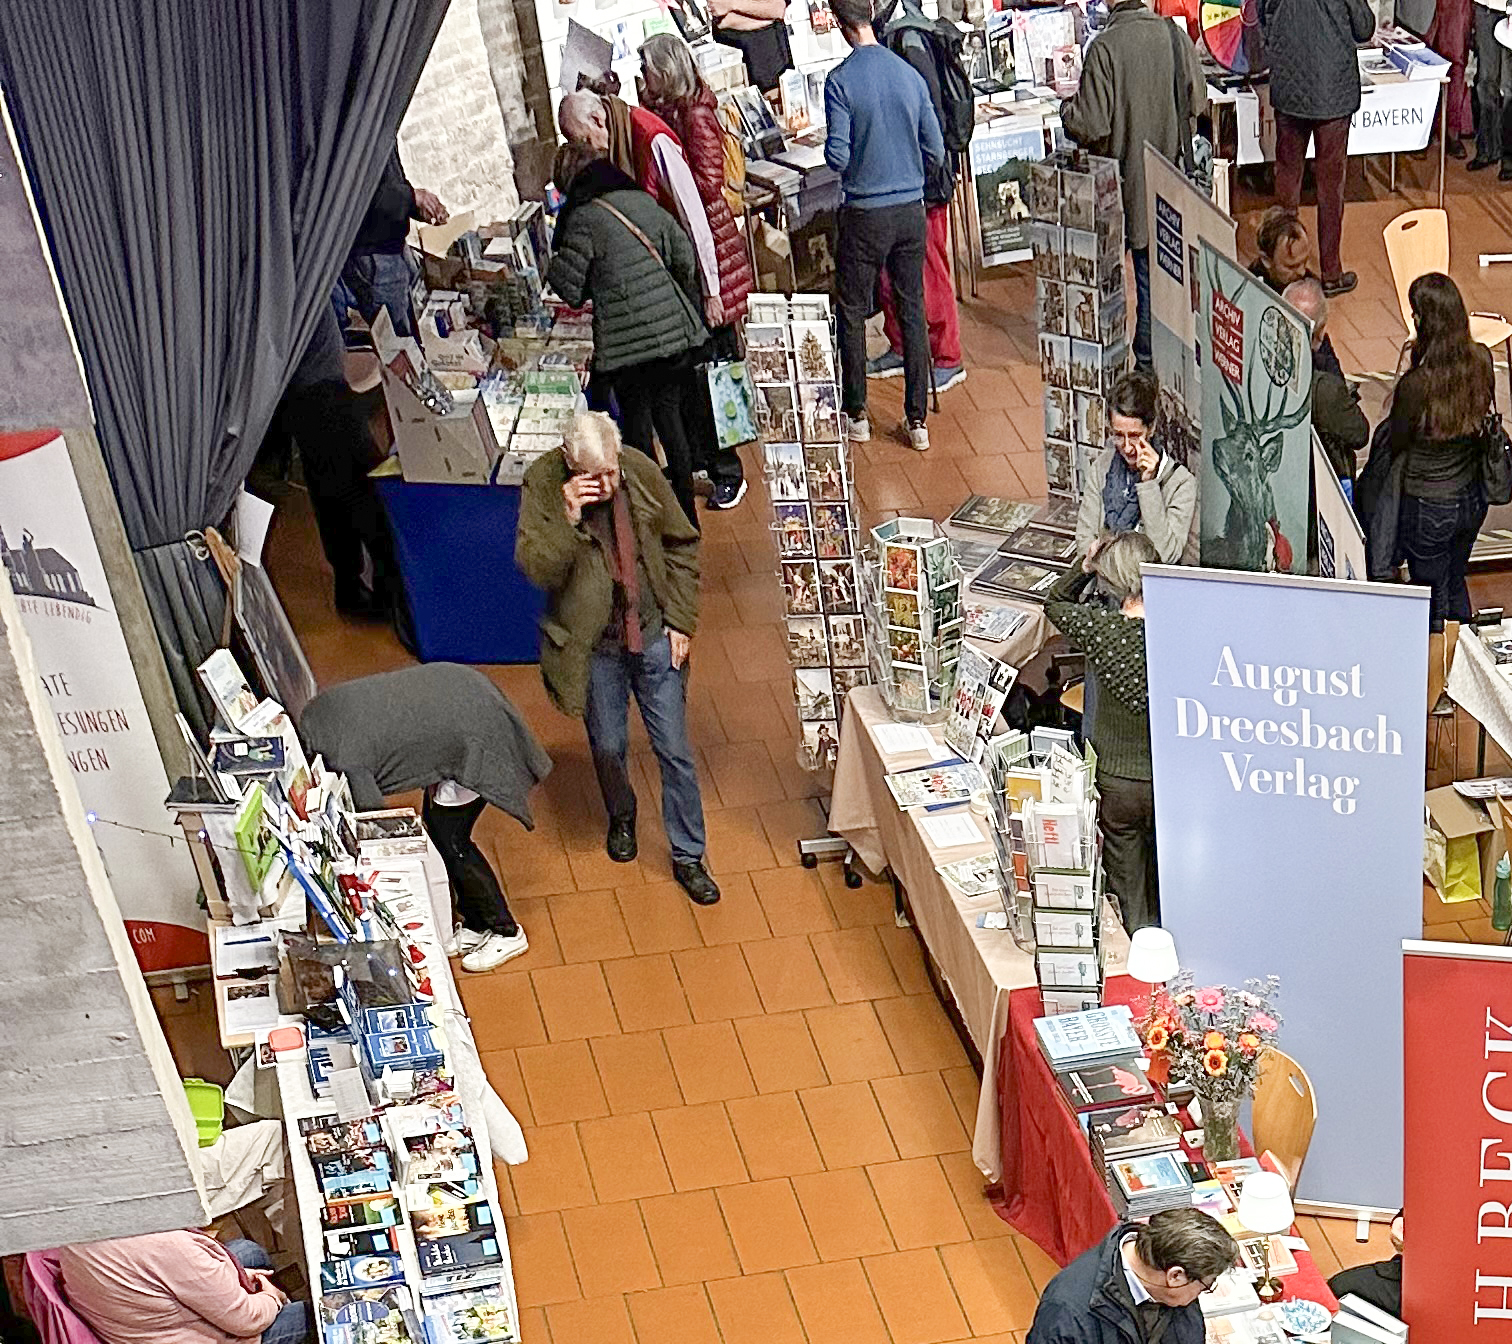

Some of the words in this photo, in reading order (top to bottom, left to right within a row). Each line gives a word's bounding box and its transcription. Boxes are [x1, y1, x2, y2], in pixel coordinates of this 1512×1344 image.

[1363, 108, 1423, 128] BAYERN
[1158, 200, 1181, 228] ARCHIV
[1158, 225, 1181, 253] VERLAG
[1158, 249, 1182, 280] WERNER
[1214, 296, 1241, 326] ARCHIV
[1214, 323, 1240, 353] VERLAG
[1214, 350, 1240, 379] WERNER
[44, 602, 92, 624] LEBENDIG
[1210, 646, 1365, 707] August
[1173, 697, 1404, 755] Dreesbach
[1219, 752, 1360, 815] Verlag
